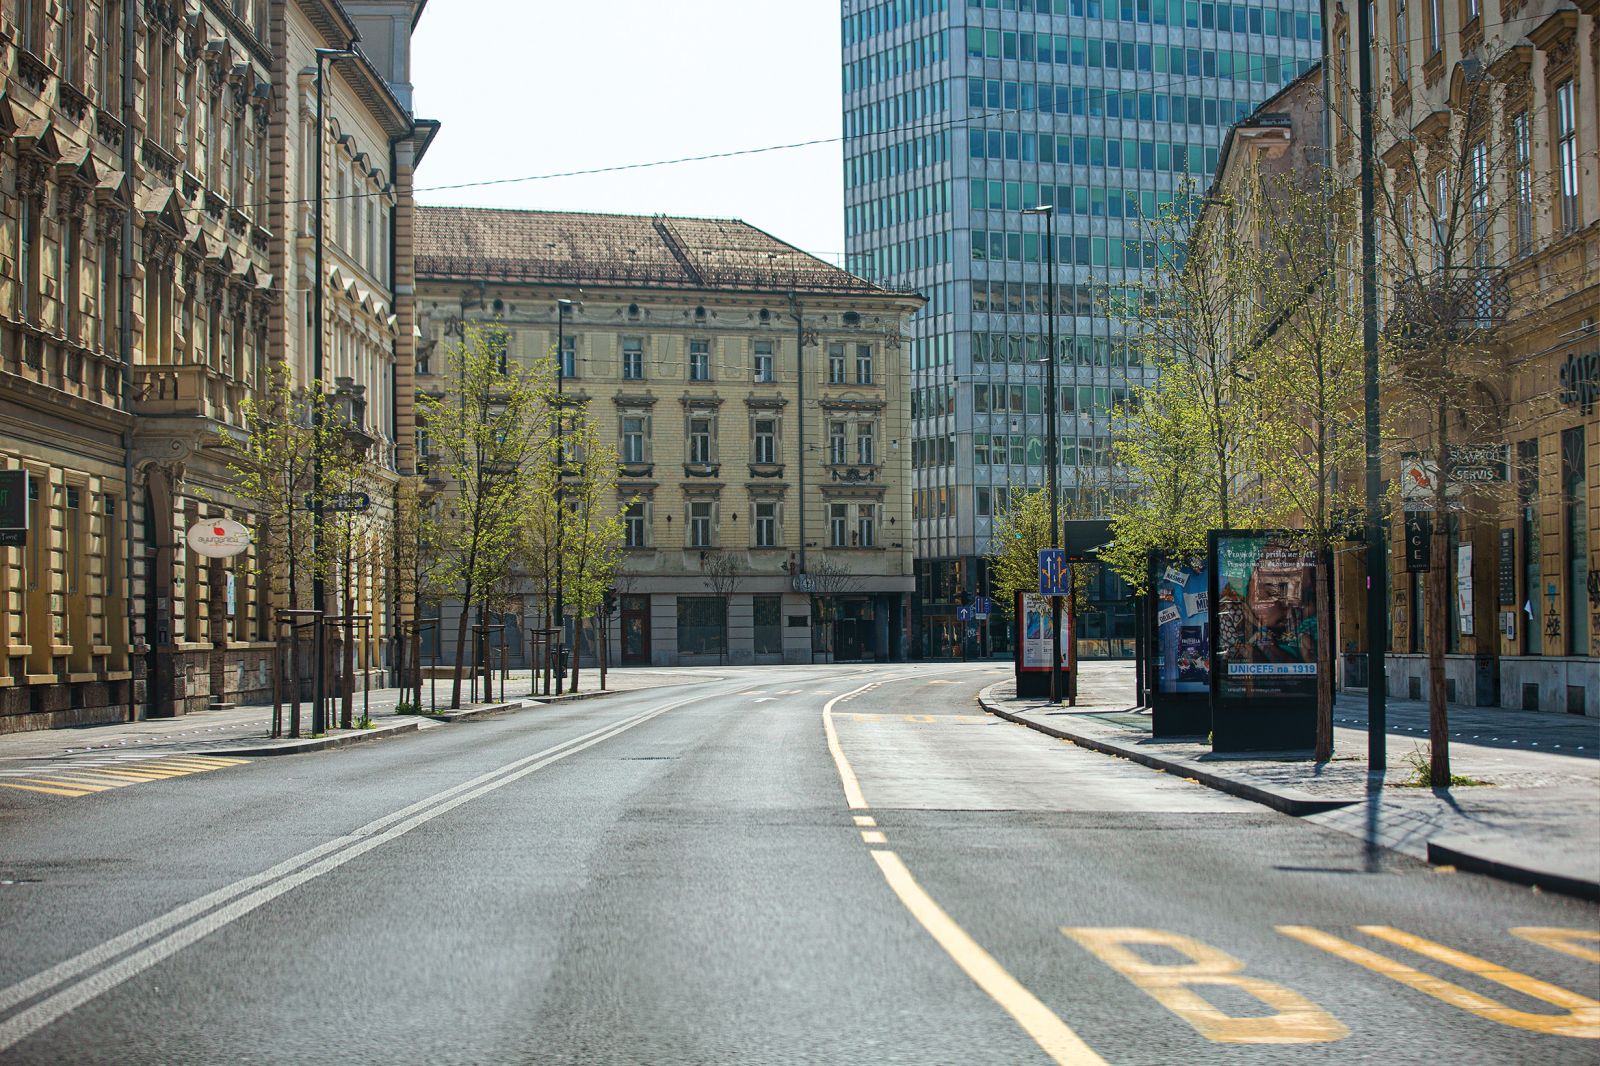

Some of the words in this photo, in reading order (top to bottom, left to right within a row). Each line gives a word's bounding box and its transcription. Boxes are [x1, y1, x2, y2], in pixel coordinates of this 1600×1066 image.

[1456, 469, 1494, 480] SERVIS
[1229, 663, 1274, 674] UNICEF5
[1276, 665, 1289, 674] na
[1292, 663, 1316, 674] 1919
